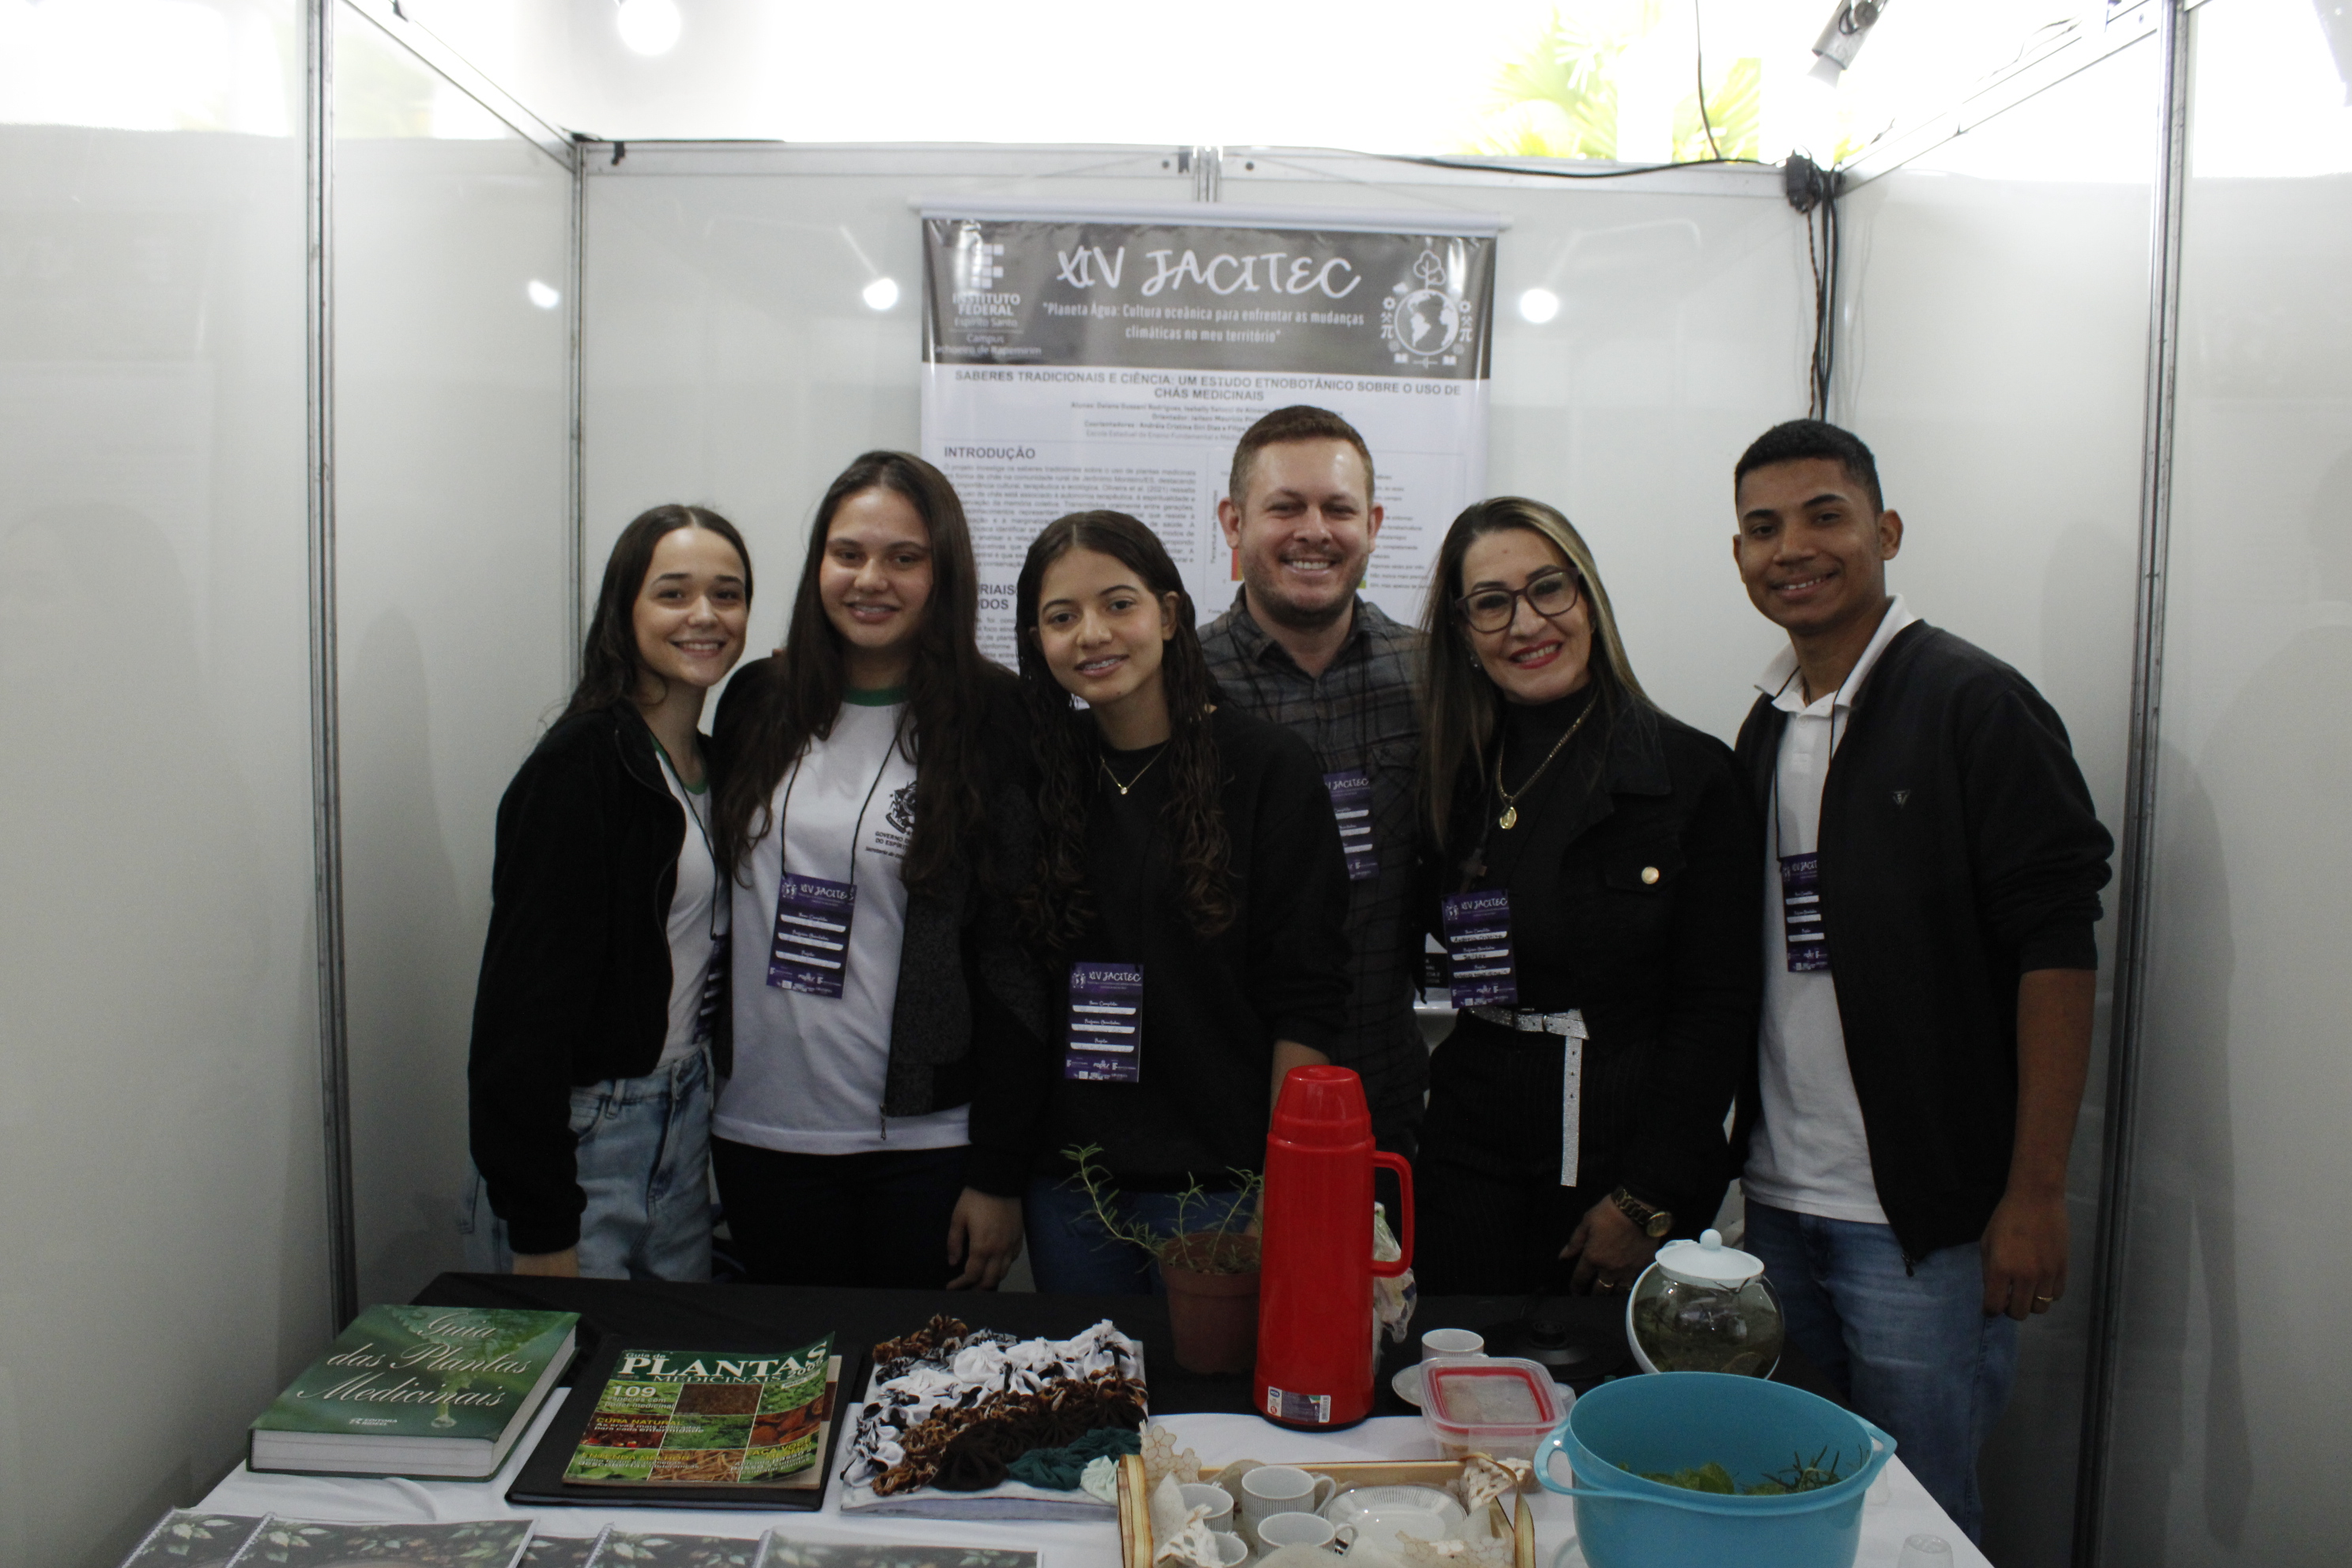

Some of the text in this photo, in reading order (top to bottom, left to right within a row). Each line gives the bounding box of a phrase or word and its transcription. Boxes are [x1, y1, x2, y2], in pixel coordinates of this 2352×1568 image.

[1057, 245, 1362, 299] XIV JACITEC
[952, 293, 1021, 306] INSTITUTO
[958, 304, 1014, 316] FEDERAL
[1123, 303, 1162, 318] Cultura
[1164, 304, 1212, 320] oceânica
[1216, 309, 1240, 322] para
[1242, 307, 1292, 322] enfrentar
[1295, 311, 1309, 323] as
[1310, 310, 1365, 327] mudanças
[991, 318, 1018, 327] Santo
[1125, 324, 1182, 341] climáticas
[1185, 328, 1198, 341] no
[1200, 329, 1223, 341] meu
[966, 334, 1004, 345] Campus
[956, 370, 1461, 396] SABERES TRADICIONAIS E CIÊNCIA: UM ESTUDO ETNOBOTÂNICO SOBRE O USO DE
[1154, 387, 1265, 401] CHÁS MEDICINAIS
[944, 445, 1036, 461] INTRODUÇÃO
[980, 583, 1016, 596] RIAIS
[981, 598, 1009, 610] DOS
[1332, 778, 1370, 790] JACITEC
[875, 831, 903, 842] GOVERNO
[885, 839, 908, 850] ESPÍRIT
[1474, 897, 1508, 910] JACITEC
[1089, 971, 1142, 982] XIV JACITEC
[416, 1310, 497, 1338] Guia
[326, 1342, 533, 1374] das Plantas
[618, 1340, 827, 1378] PLANTAS
[654, 1374, 782, 1383] MEDICINAIS
[296, 1371, 507, 1407] Medicinais
[612, 1385, 657, 1397] 109
[581, 1452, 636, 1461] ENTENDA
